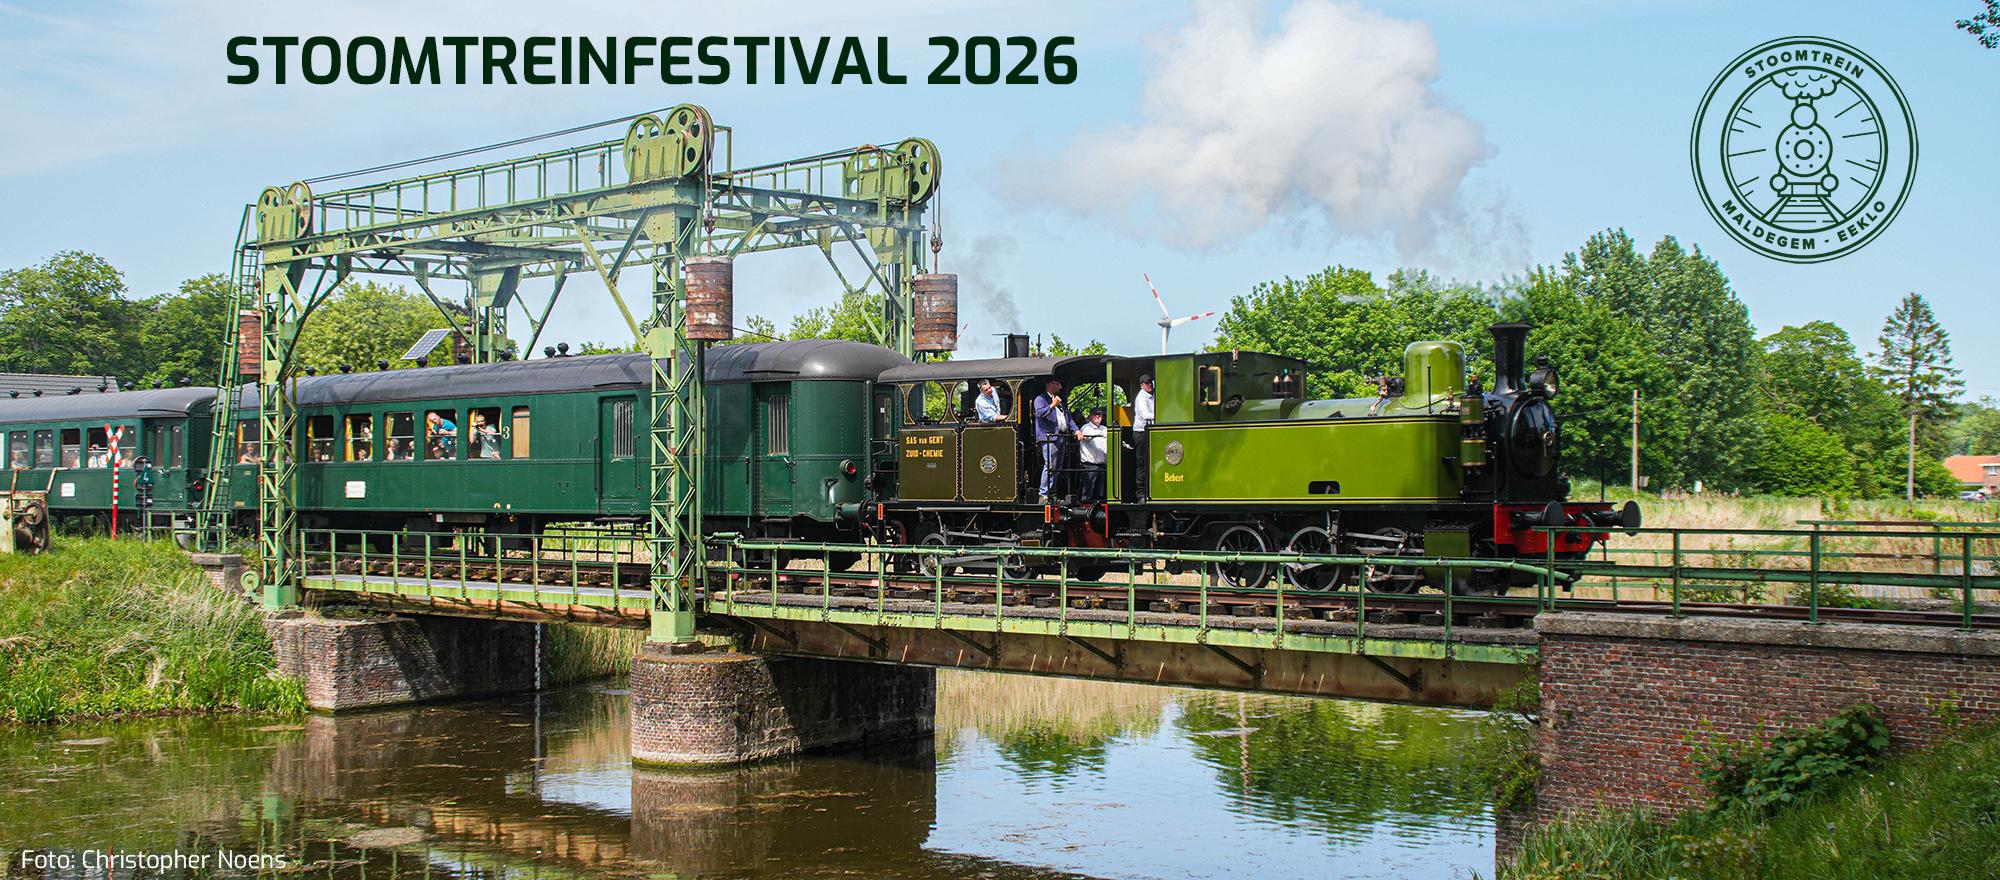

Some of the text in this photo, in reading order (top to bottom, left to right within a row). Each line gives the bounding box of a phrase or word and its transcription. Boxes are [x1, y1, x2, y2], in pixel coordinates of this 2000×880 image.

[502, 425, 510, 440] 3
[905, 436, 917, 445] SAS
[928, 435, 944, 445] GENT
